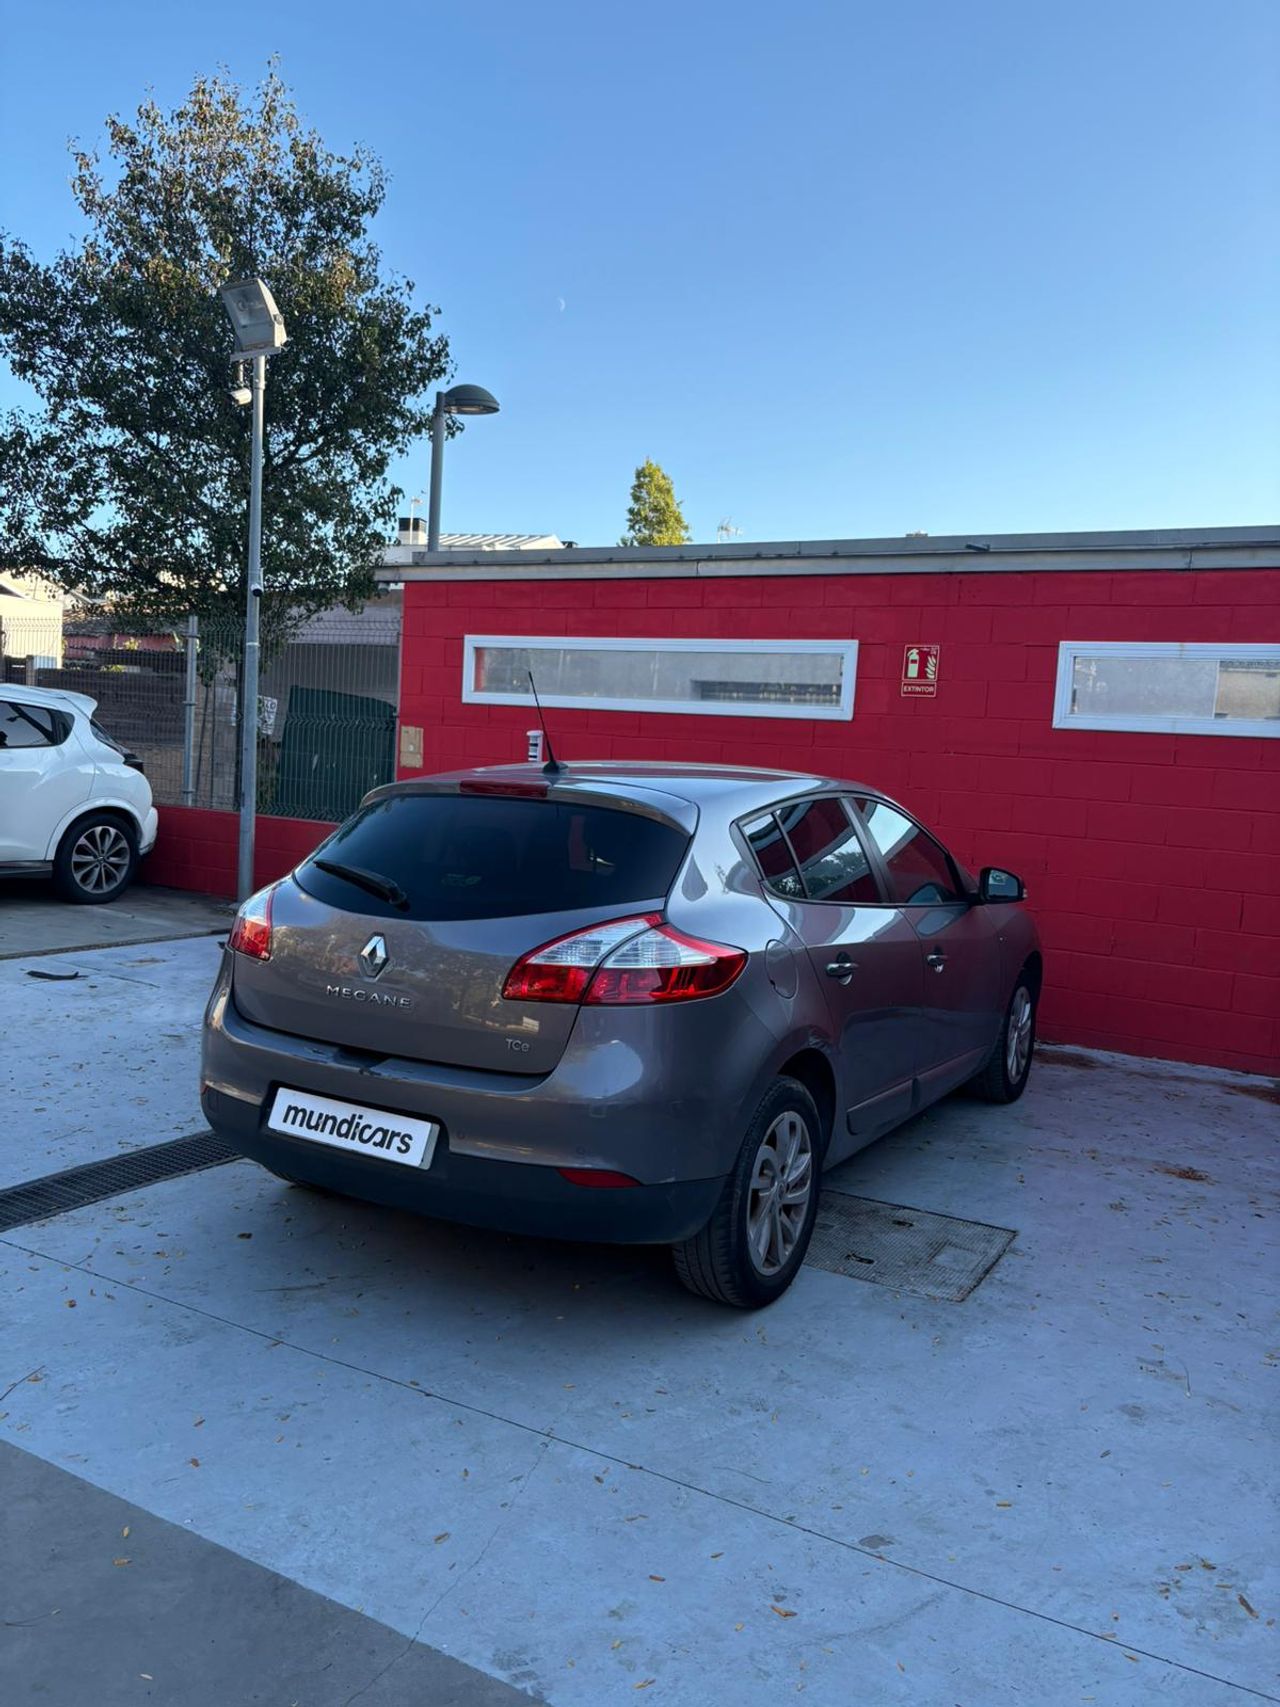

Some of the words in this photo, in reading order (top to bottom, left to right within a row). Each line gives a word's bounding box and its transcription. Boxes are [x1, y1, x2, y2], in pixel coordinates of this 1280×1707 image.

[903, 685, 934, 693] EXTINTOR
[326, 985, 411, 1008] MEGANE
[505, 1038, 529, 1052] TCe
[282, 1104, 413, 1154] mundicars
